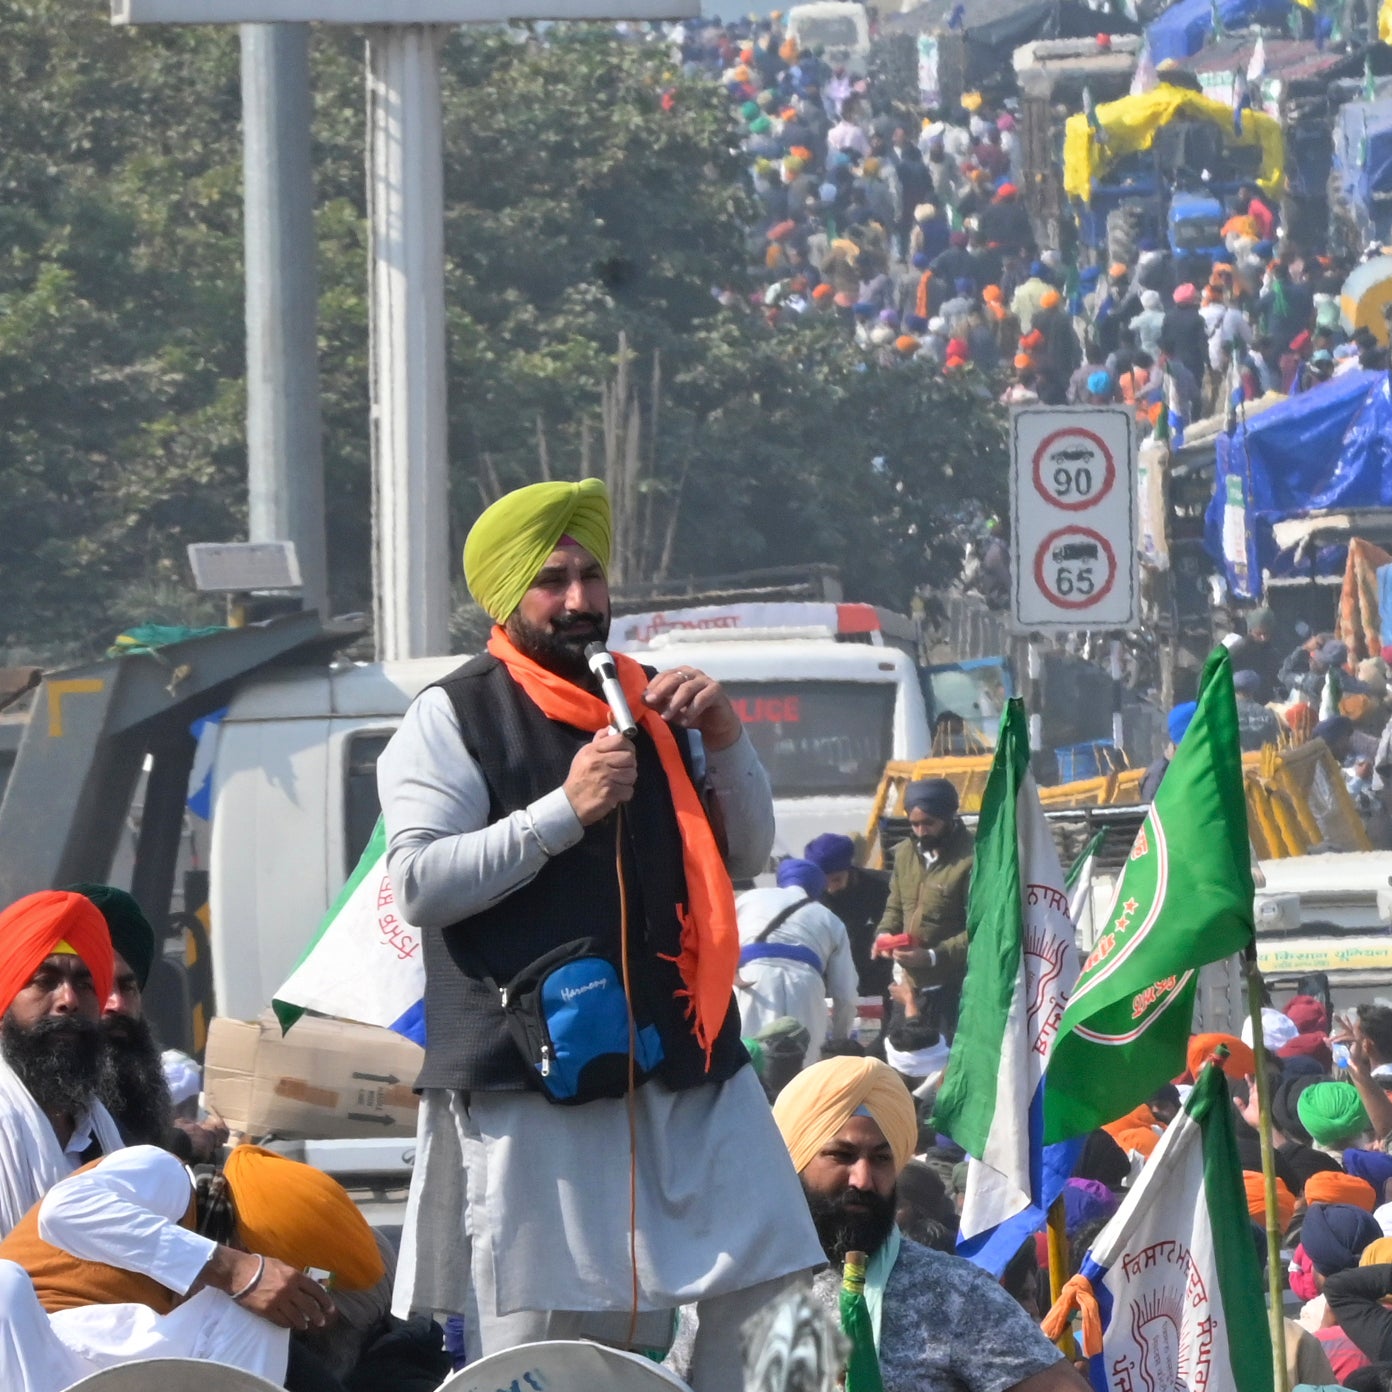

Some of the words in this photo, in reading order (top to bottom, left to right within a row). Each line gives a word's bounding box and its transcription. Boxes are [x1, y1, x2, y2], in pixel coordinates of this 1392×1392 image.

[1053, 468, 1092, 496] 90
[1055, 567, 1094, 596] 65
[731, 695, 800, 723] LICE
[561, 976, 607, 1001] Harmony
